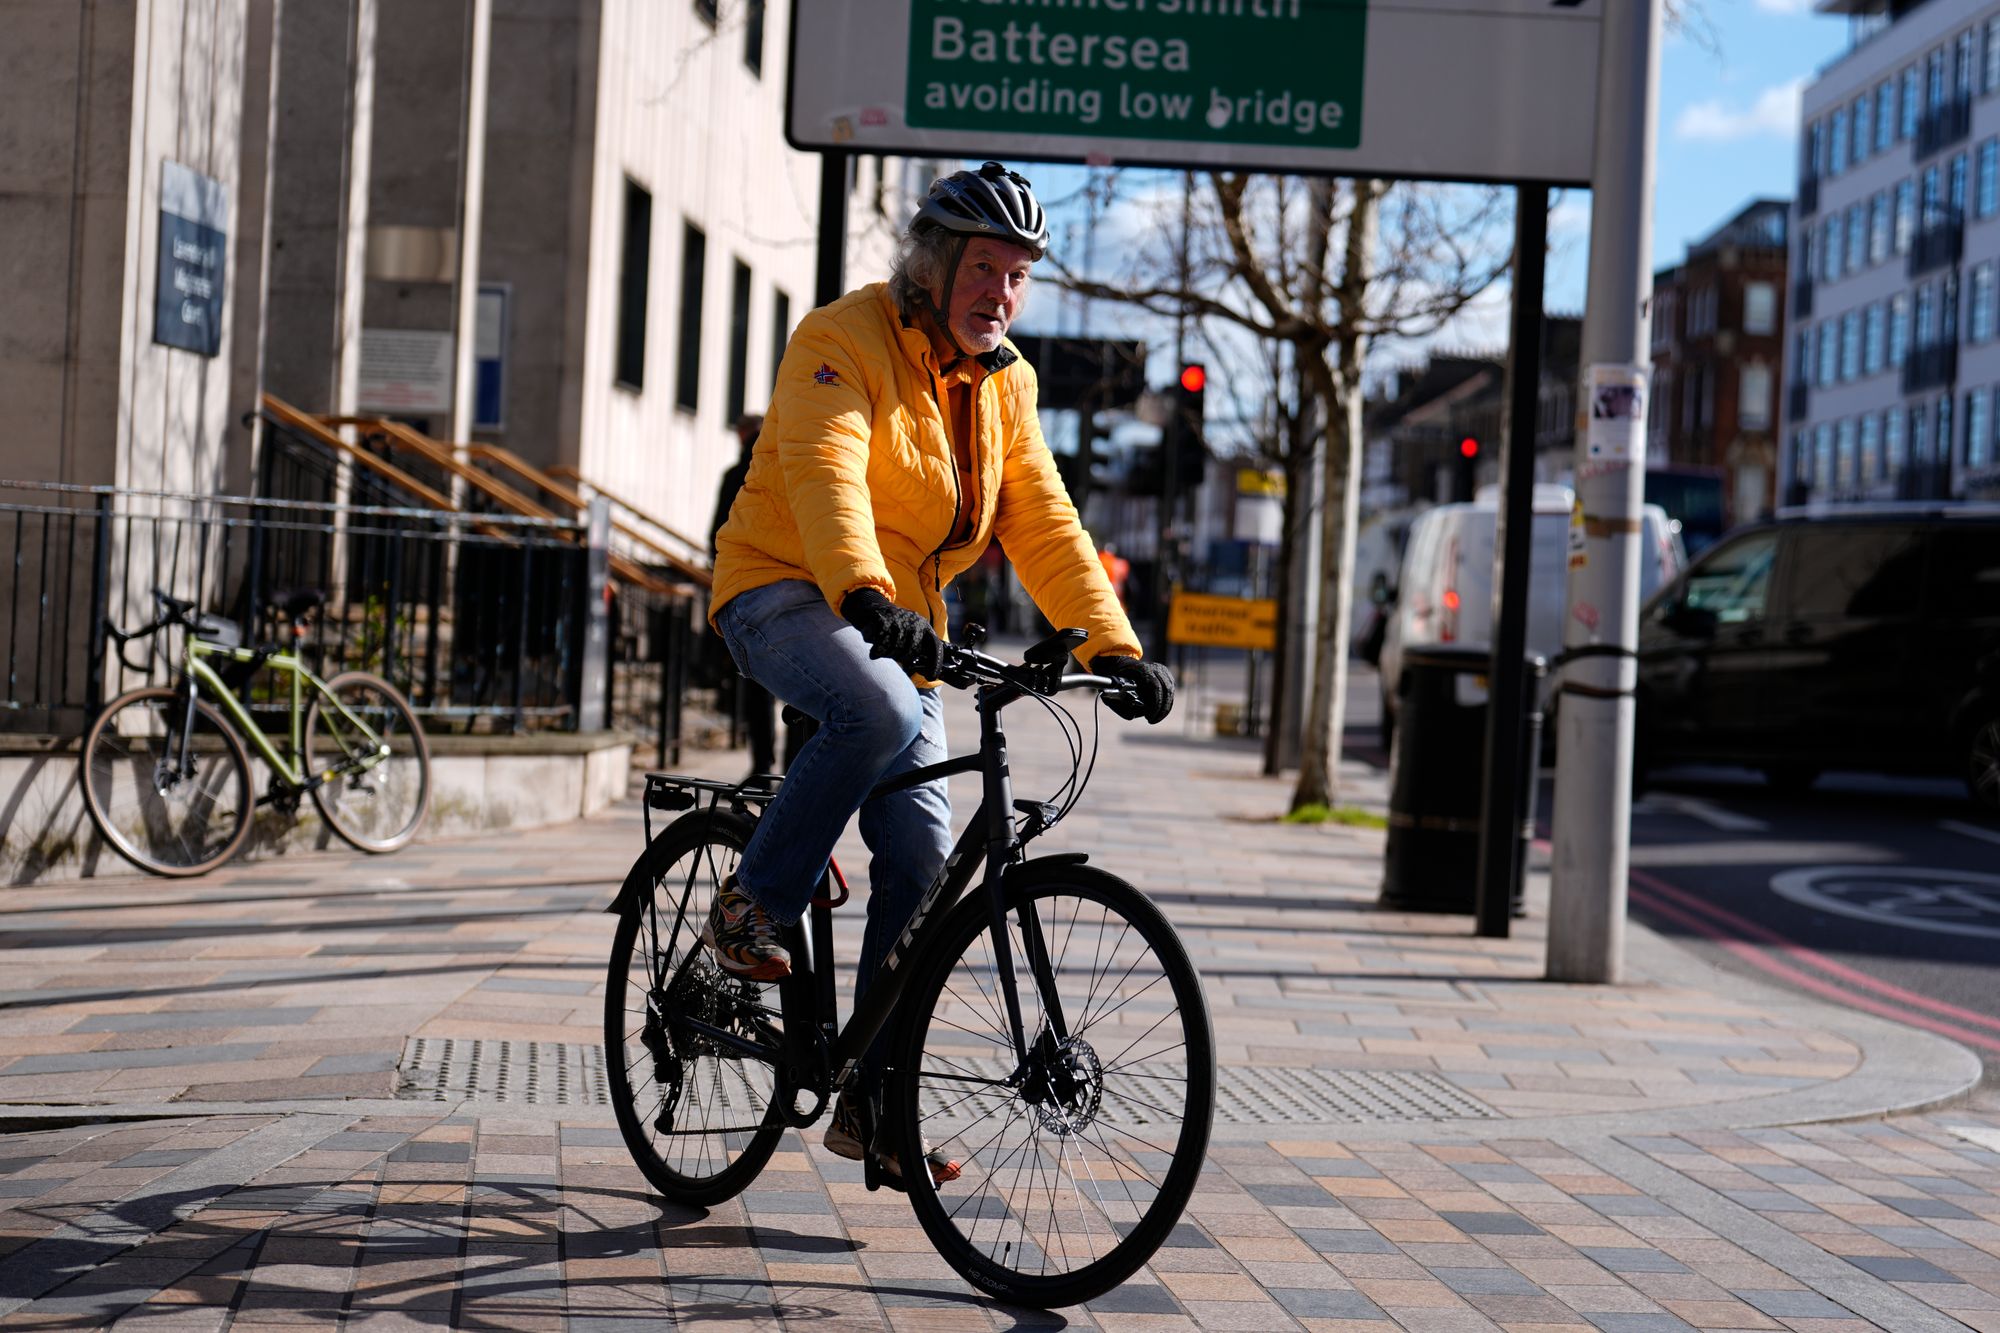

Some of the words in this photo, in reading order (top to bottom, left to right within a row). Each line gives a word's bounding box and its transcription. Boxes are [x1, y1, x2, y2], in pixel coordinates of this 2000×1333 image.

[931, 15, 1190, 71] Battersea
[924, 77, 1101, 123] avoiding
[1119, 82, 1193, 120] low
[1208, 86, 1344, 134] bridge
